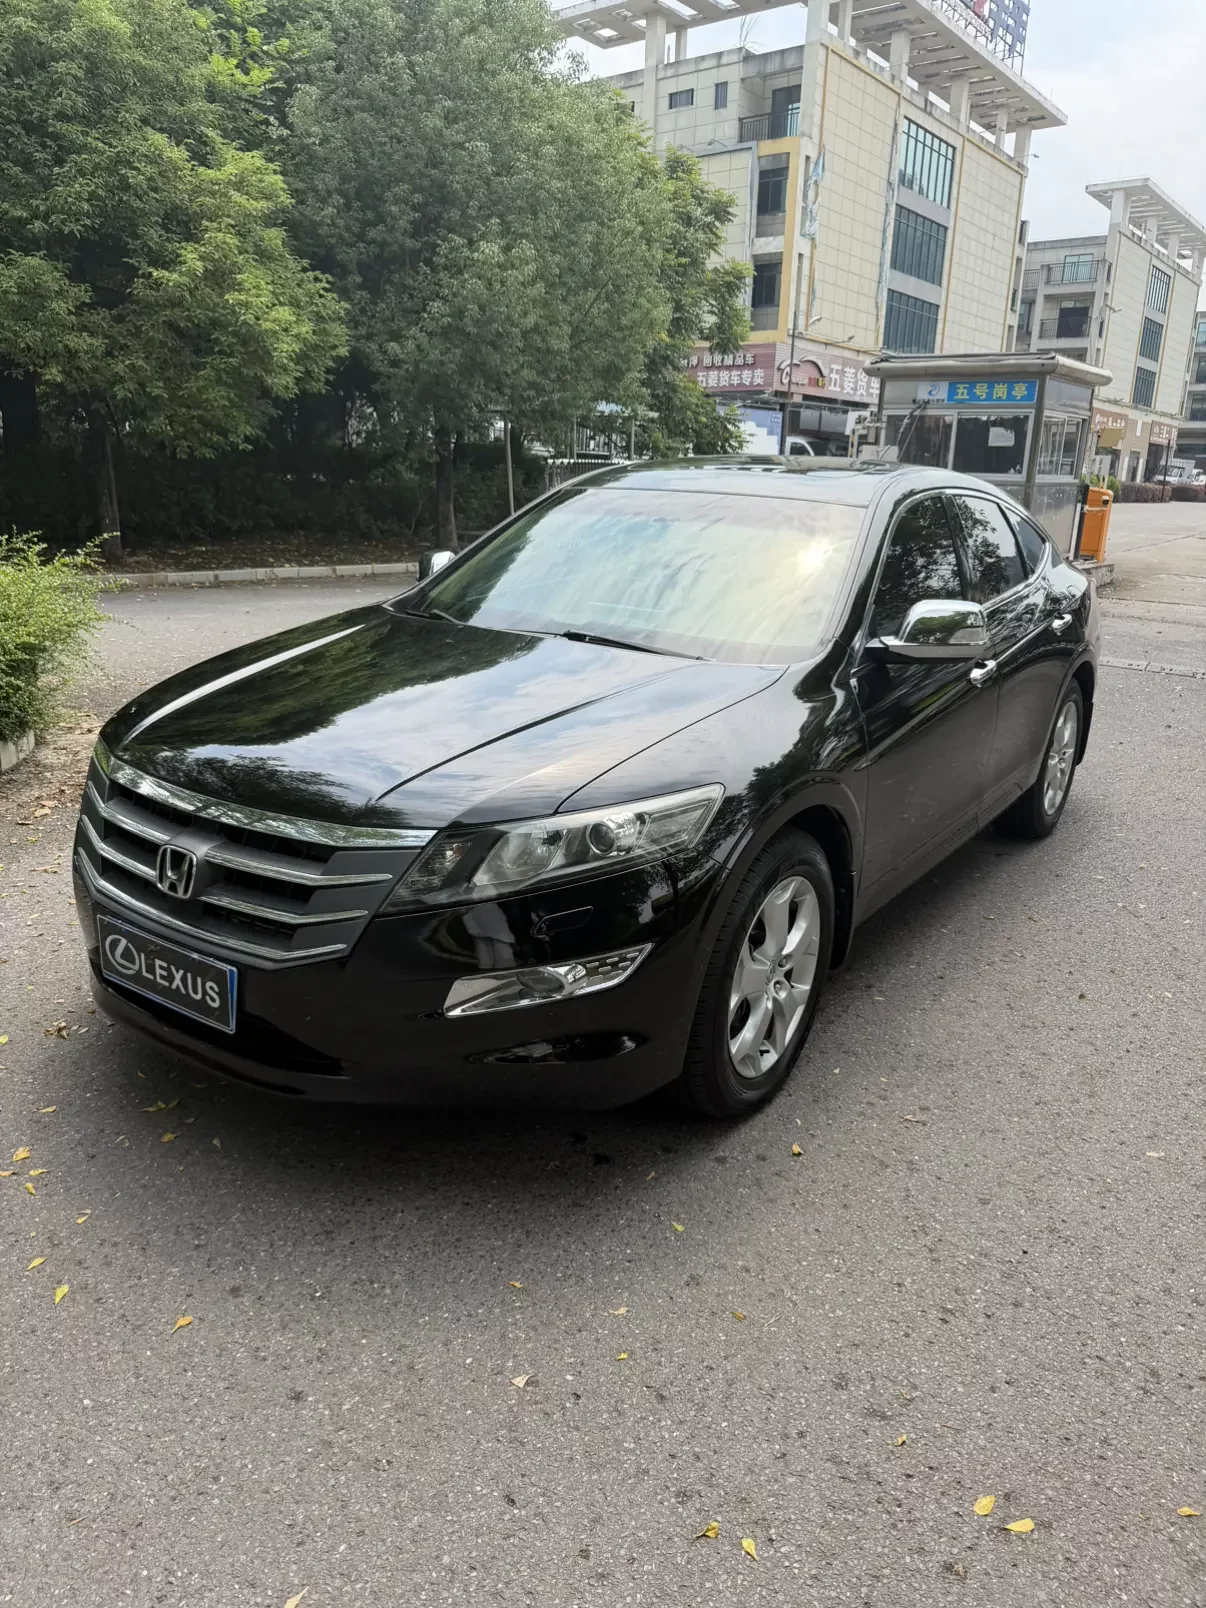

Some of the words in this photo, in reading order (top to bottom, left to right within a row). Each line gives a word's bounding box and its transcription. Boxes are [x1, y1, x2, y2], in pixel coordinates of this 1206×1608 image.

[697, 368, 764, 387] 五菱货车专卖
[954, 382, 1028, 400] 五号岗亭
[140, 952, 220, 1008] LEXUS
